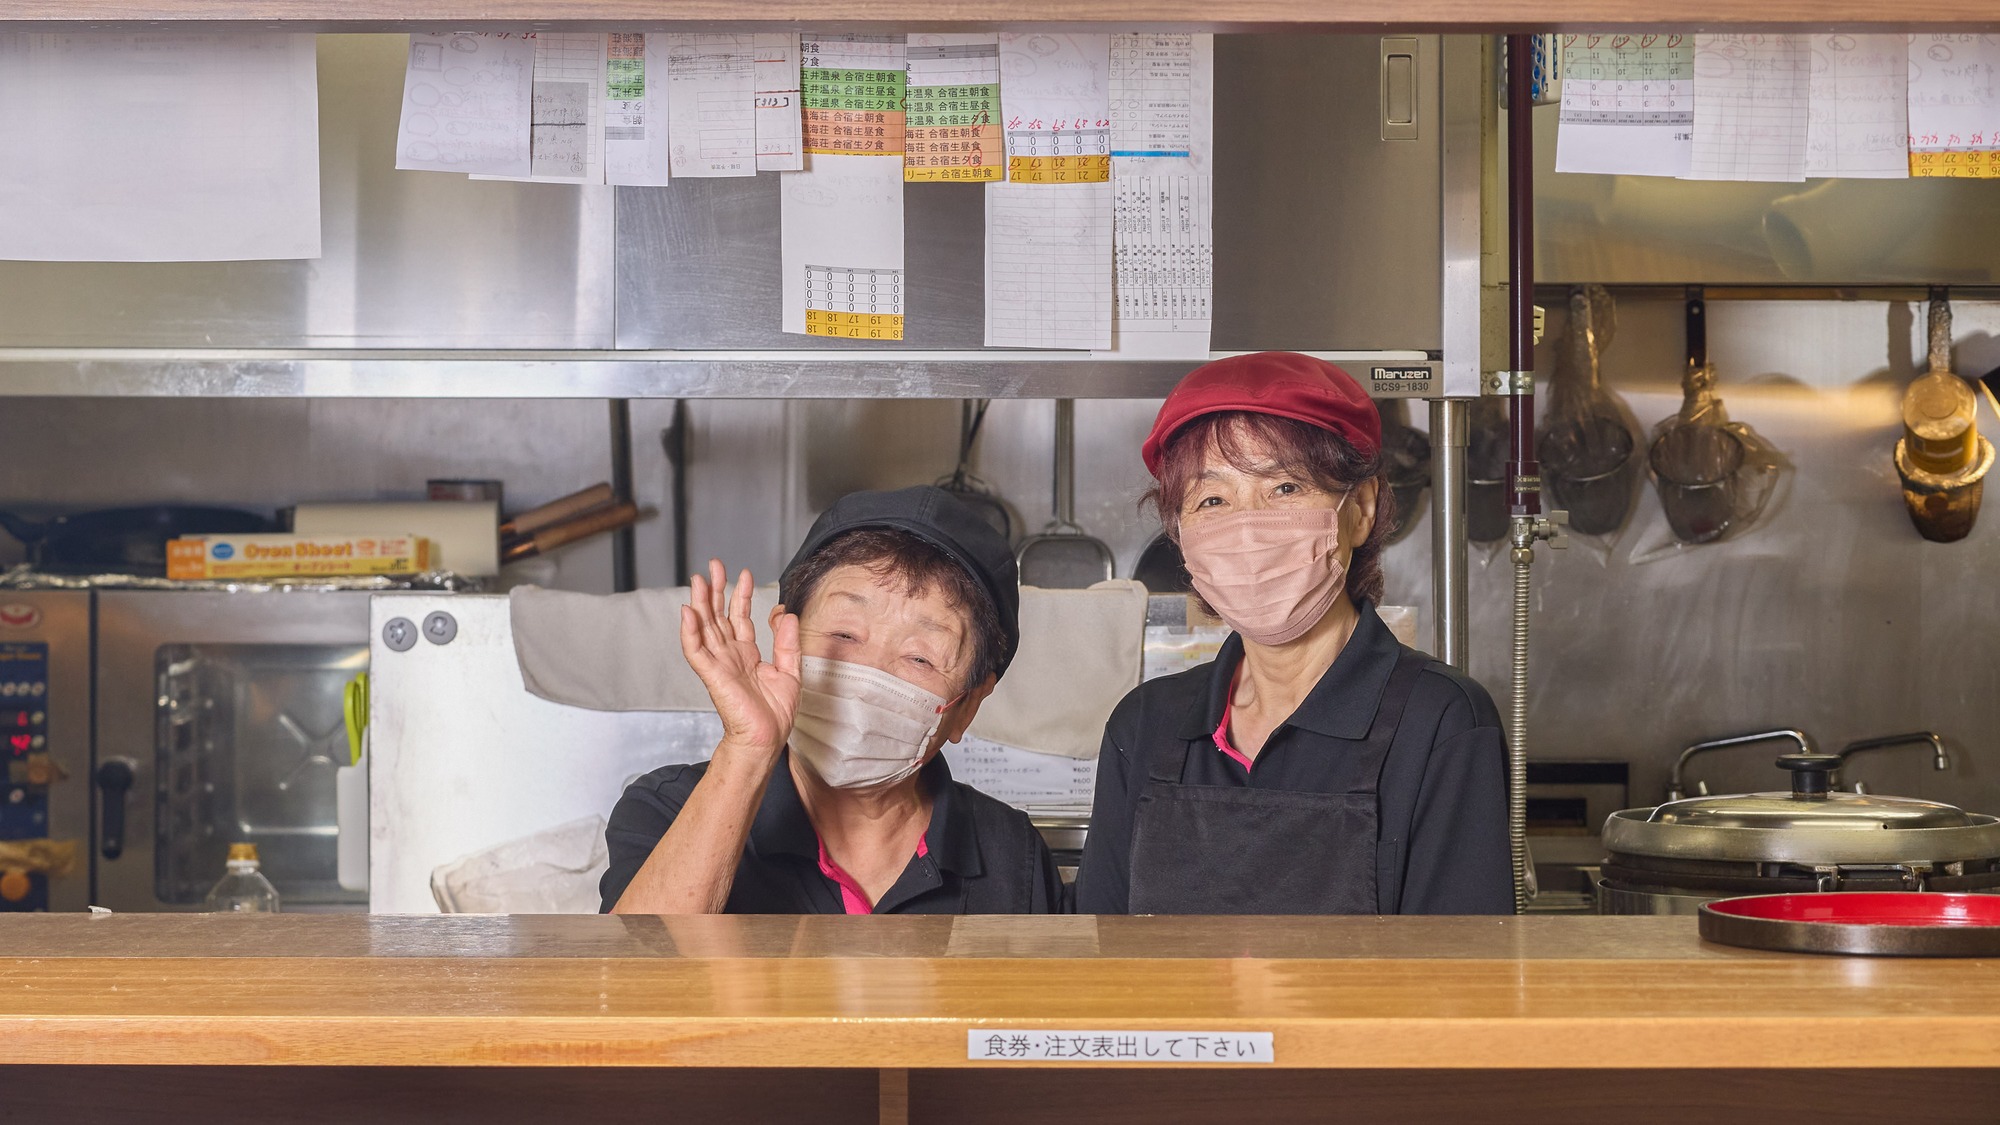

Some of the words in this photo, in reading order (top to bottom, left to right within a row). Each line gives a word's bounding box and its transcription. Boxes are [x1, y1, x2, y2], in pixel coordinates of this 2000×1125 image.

[800, 43, 820, 54] 朝食
[801, 56, 820, 66] 夕食
[801, 70, 840, 81] 五井温泉
[844, 71, 897, 83] 合宿生朝食
[801, 83, 840, 94] 五井温泉
[844, 85, 897, 96] 合宿生昼食
[938, 86, 991, 98] 合宿生朝食
[801, 97, 840, 108] 五井温泉
[844, 99, 897, 110] 合宿生夕食
[938, 100, 991, 111] 合宿生昼食
[833, 112, 885, 123] 合宿生朝食
[833, 126, 885, 137] 合宿生昼食
[929, 128, 982, 139] 合宿生朝食
[1009, 136, 1015, 145] 0
[1030, 136, 1036, 145] 0
[1053, 136, 1059, 145] 0
[1076, 135, 1082, 144] 0
[1099, 134, 1105, 144] 0
[833, 139, 885, 150] 合宿生夕食
[929, 141, 982, 152] 合宿生昼食
[1099, 144, 1105, 154] 0
[1010, 146, 1015, 155] 0
[1031, 146, 1036, 155] 0
[1053, 146, 1059, 155] 0
[1076, 145, 1082, 154] 0
[1921, 155, 1933, 163] 26
[1945, 154, 1956, 163] 27
[1968, 153, 1980, 162] 26
[941, 168, 993, 179] 合宿生朝食
[1011, 171, 1021, 180] 17
[1032, 171, 1042, 180] 17
[1055, 171, 1065, 180] 21
[1078, 171, 1089, 180] 21
[1922, 168, 1933, 177] 26
[1945, 168, 1956, 176] 27
[1968, 167, 1980, 176] 26
[806, 270, 812, 279] 0
[827, 272, 833, 281] 0
[849, 273, 854, 282] 0
[871, 274, 877, 283] 0
[893, 275, 899, 284] 0
[806, 280, 812, 289] 0
[827, 282, 833, 291] 0
[849, 283, 854, 292] 0
[871, 284, 877, 293] 0
[893, 285, 899, 294] 0
[806, 290, 812, 299] 0
[827, 292, 833, 300] 0
[849, 293, 854, 302] 0
[871, 294, 877, 303] 0
[806, 299, 812, 308] 0
[893, 295, 899, 304] 0
[827, 301, 833, 310] 0
[849, 303, 854, 312] 0
[871, 304, 877, 313] 0
[893, 304, 899, 314] 0
[807, 311, 817, 320] 18
[827, 313, 837, 322] 18
[848, 315, 859, 324] 17
[870, 316, 881, 325] 19
[807, 324, 817, 333] 18
[827, 326, 838, 335] 18
[848, 328, 859, 337] 17
[870, 329, 881, 338] 19
[1374, 368, 1429, 379] Maruzen
[1374, 382, 1429, 392] BCS9-1830
[244, 543, 293, 560] Oven
[295, 541, 353, 557] Sheet
[984, 1034, 1255, 1058] 食券・注文表出して下さい
